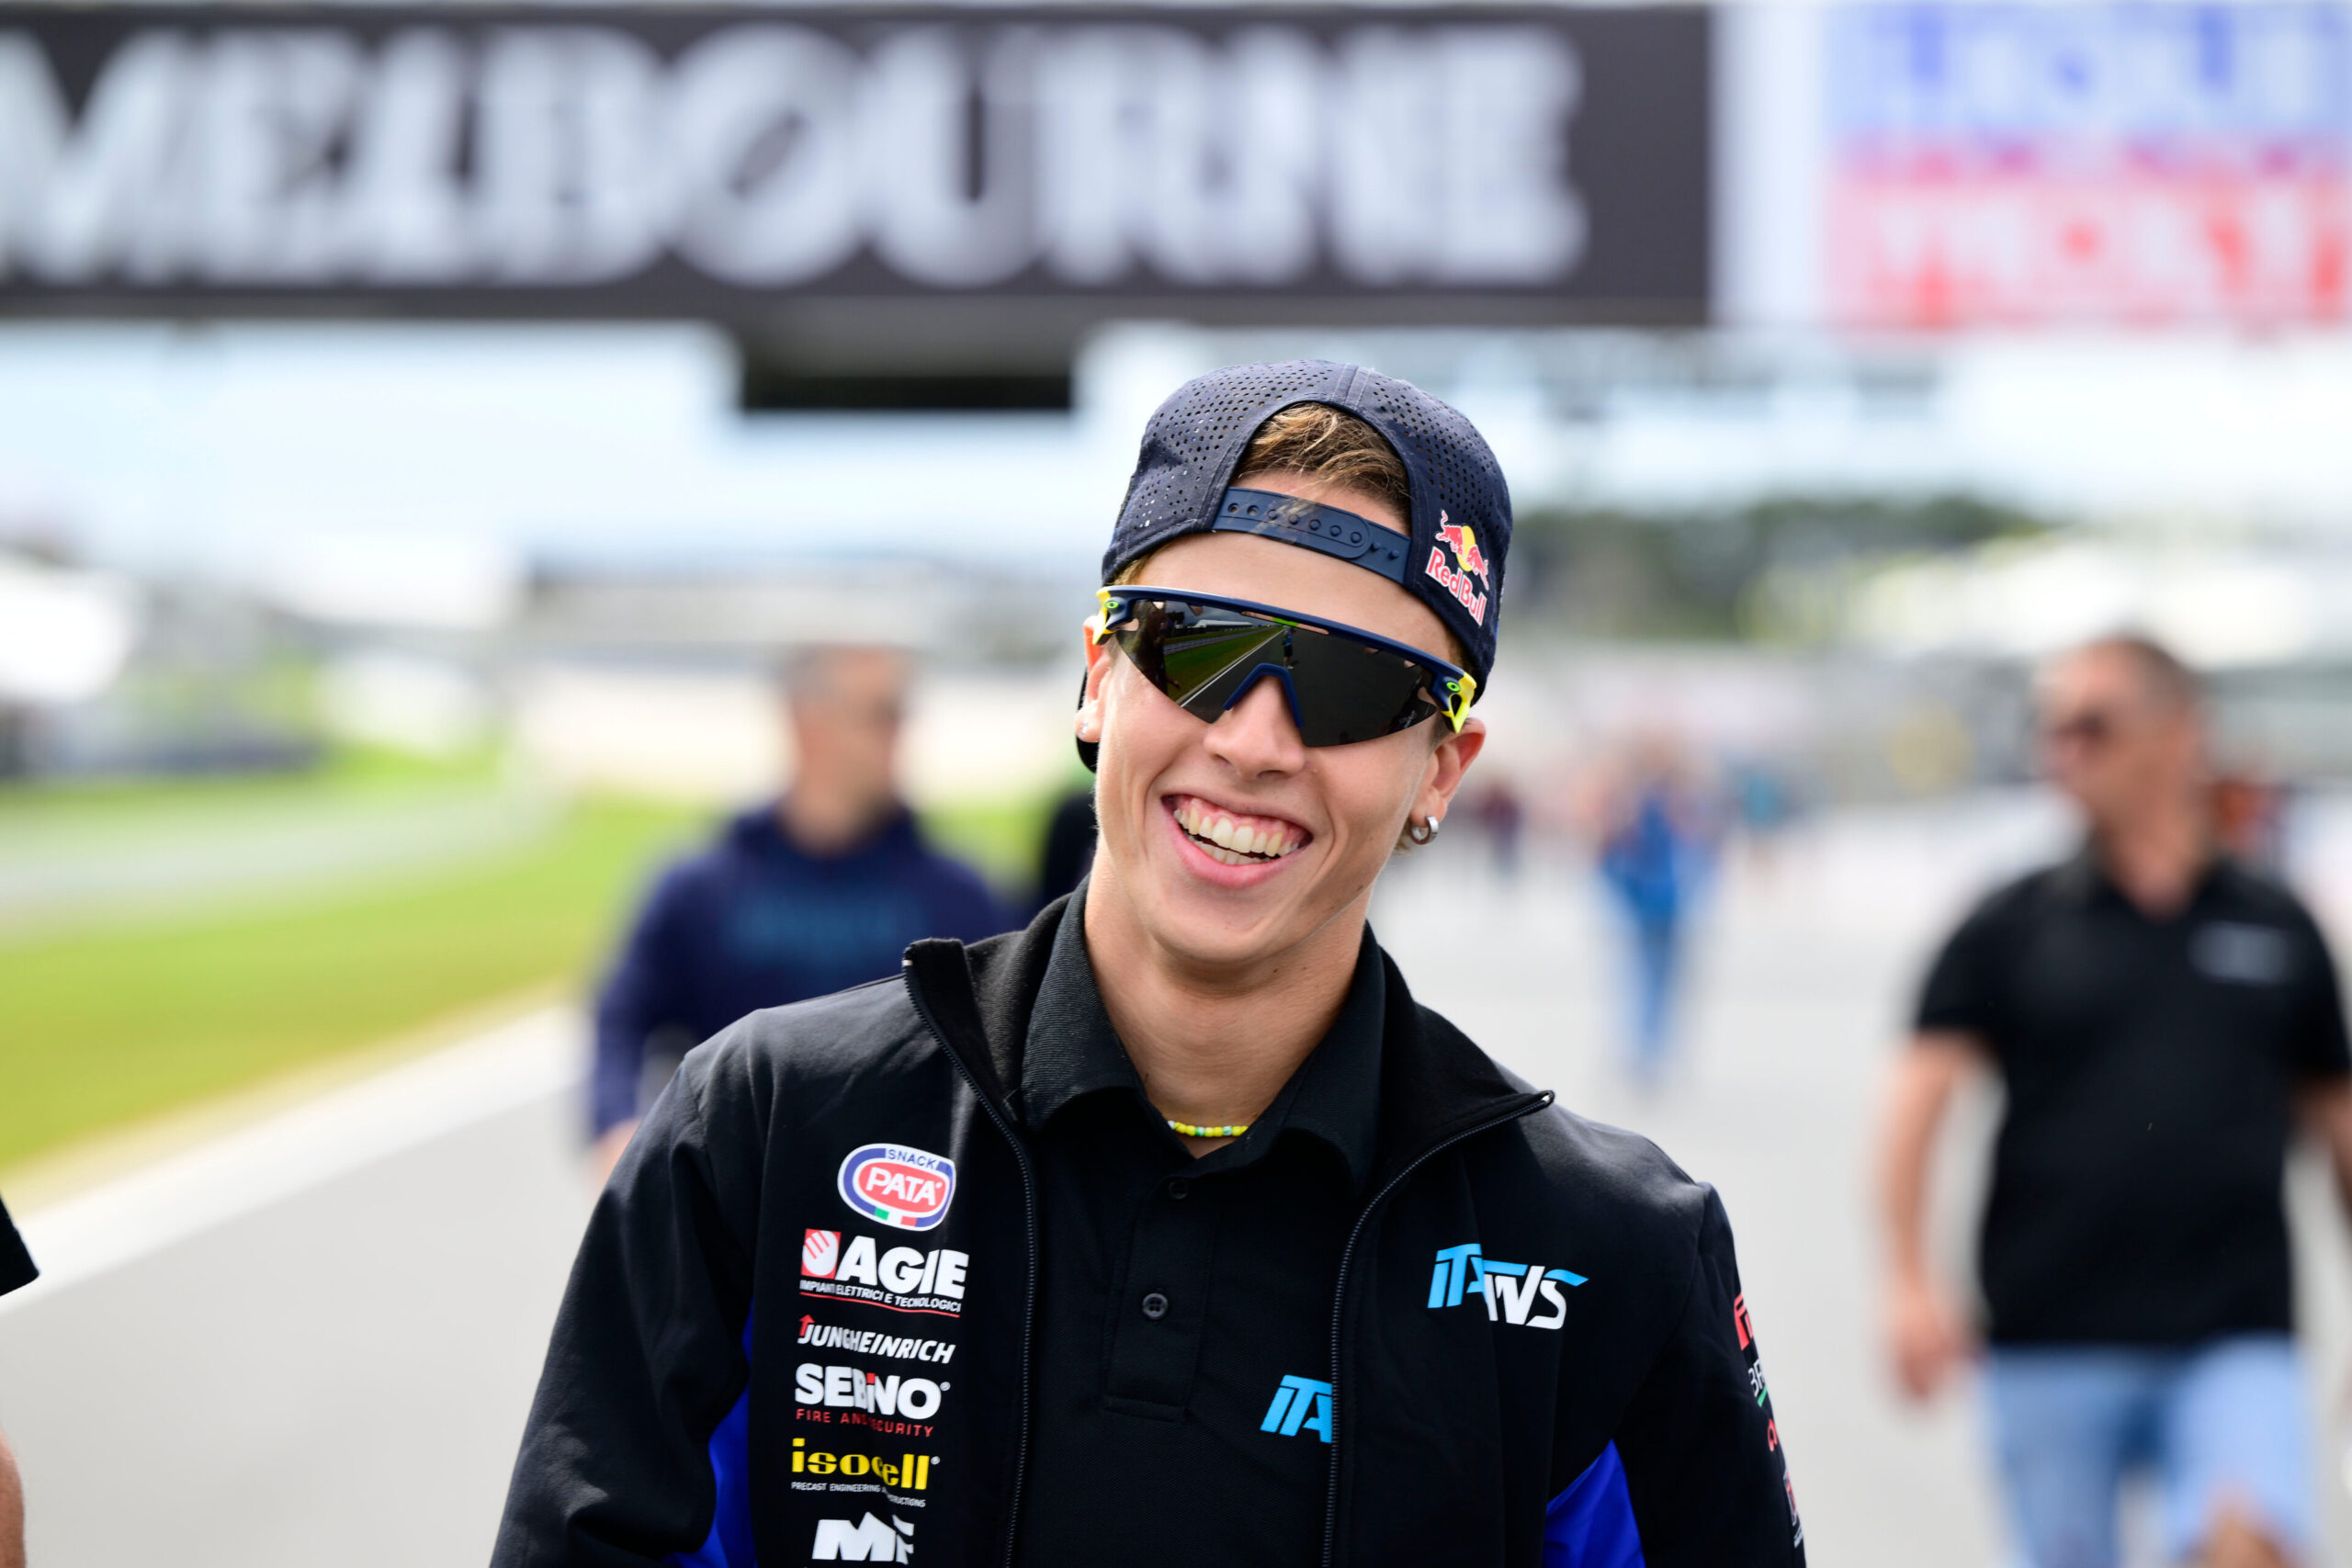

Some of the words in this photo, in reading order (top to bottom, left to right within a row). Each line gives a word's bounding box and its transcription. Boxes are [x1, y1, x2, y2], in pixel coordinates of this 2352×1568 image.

[1425, 546, 1463, 599] Red
[1458, 574, 1487, 626] Bull
[888, 1148, 936, 1169] SNACK
[834, 1235, 969, 1300] AGIE
[884, 1292, 894, 1303] E
[796, 1408, 831, 1423] FIRE
[791, 1482, 828, 1491] PRECAST
